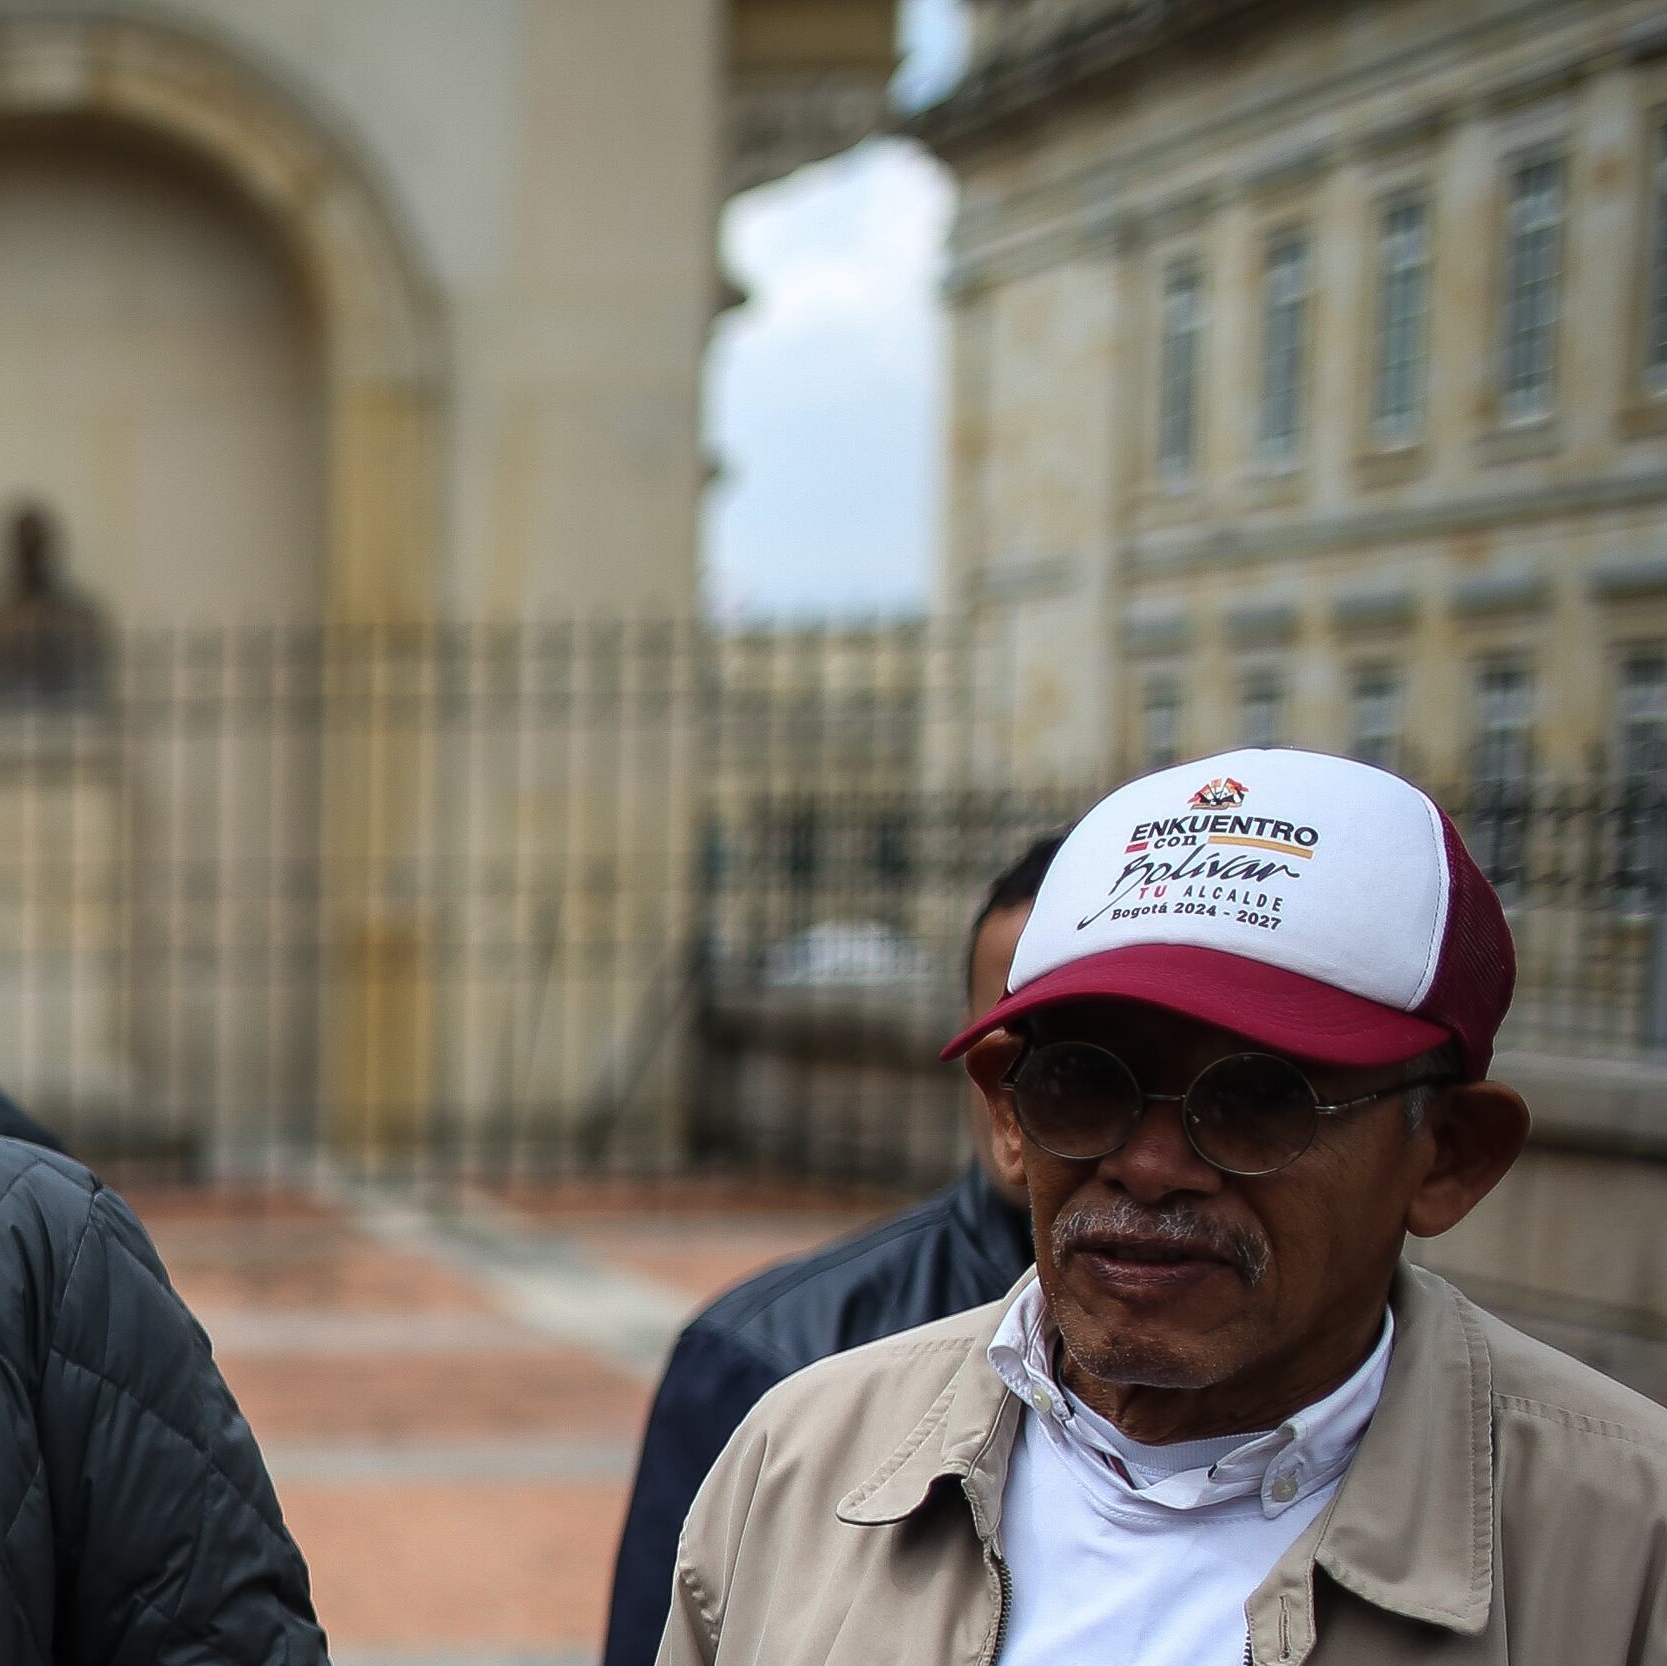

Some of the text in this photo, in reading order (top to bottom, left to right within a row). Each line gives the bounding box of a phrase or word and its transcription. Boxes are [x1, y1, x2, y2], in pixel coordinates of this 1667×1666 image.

[1129, 815, 1320, 847] ENKUENTRO
[1153, 834, 1197, 850] con
[1076, 843, 1301, 931] Bolívar
[1138, 884, 1284, 912] TU ALCALDE
[1110, 901, 1168, 921] Bogotá
[1173, 902, 1217, 917] 2024
[1235, 910, 1283, 931] 2027
